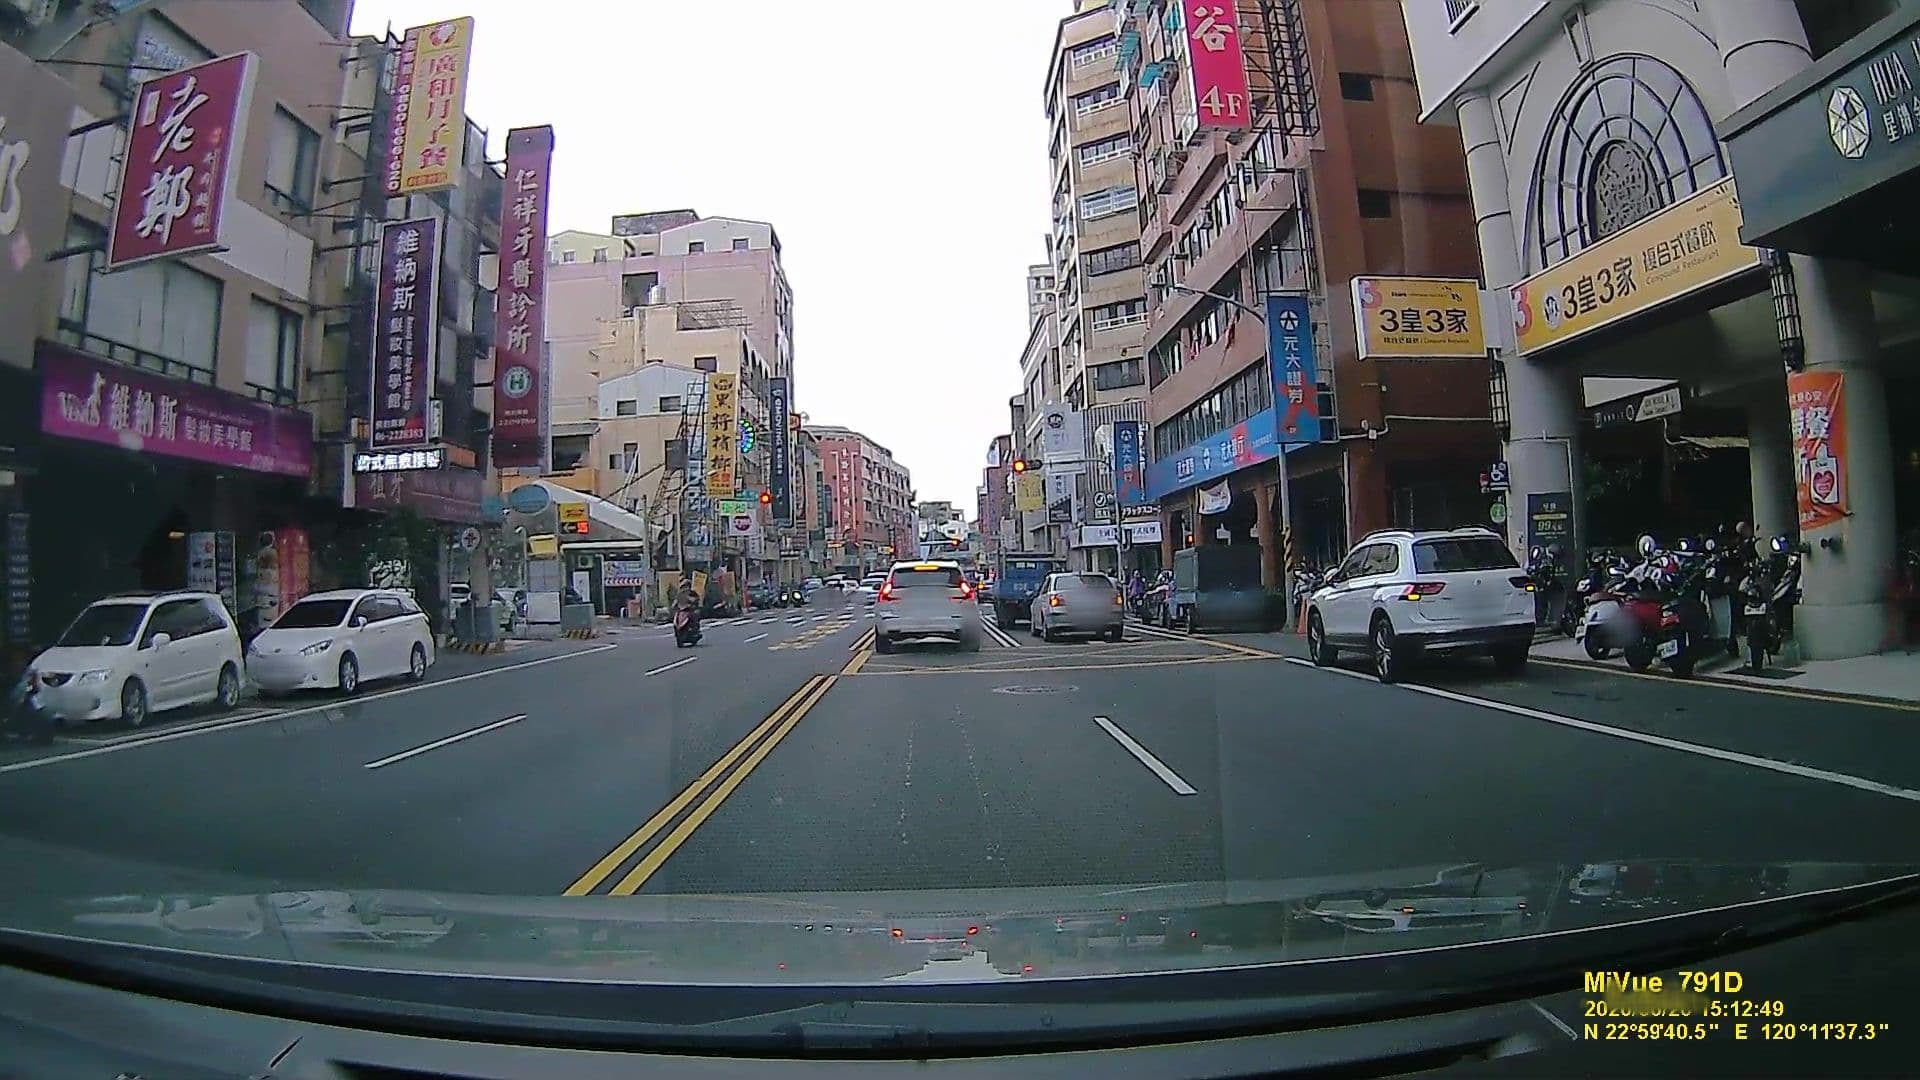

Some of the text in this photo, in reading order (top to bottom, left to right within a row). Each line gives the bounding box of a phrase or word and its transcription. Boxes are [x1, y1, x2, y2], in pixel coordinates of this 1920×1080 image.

[1200, 85, 1243, 118] 4F
[1868, 51, 1913, 105] HUA
[136, 75, 209, 245] 老鄭
[392, 229, 420, 311] 維納斯
[507, 168, 538, 355] 仁祥牙醫診所
[1562, 254, 1638, 320] 3皇3家
[1379, 307, 1469, 335] 3皇3家
[1283, 335, 1304, 405] 元大證券
[111, 383, 178, 441] 維納斯
